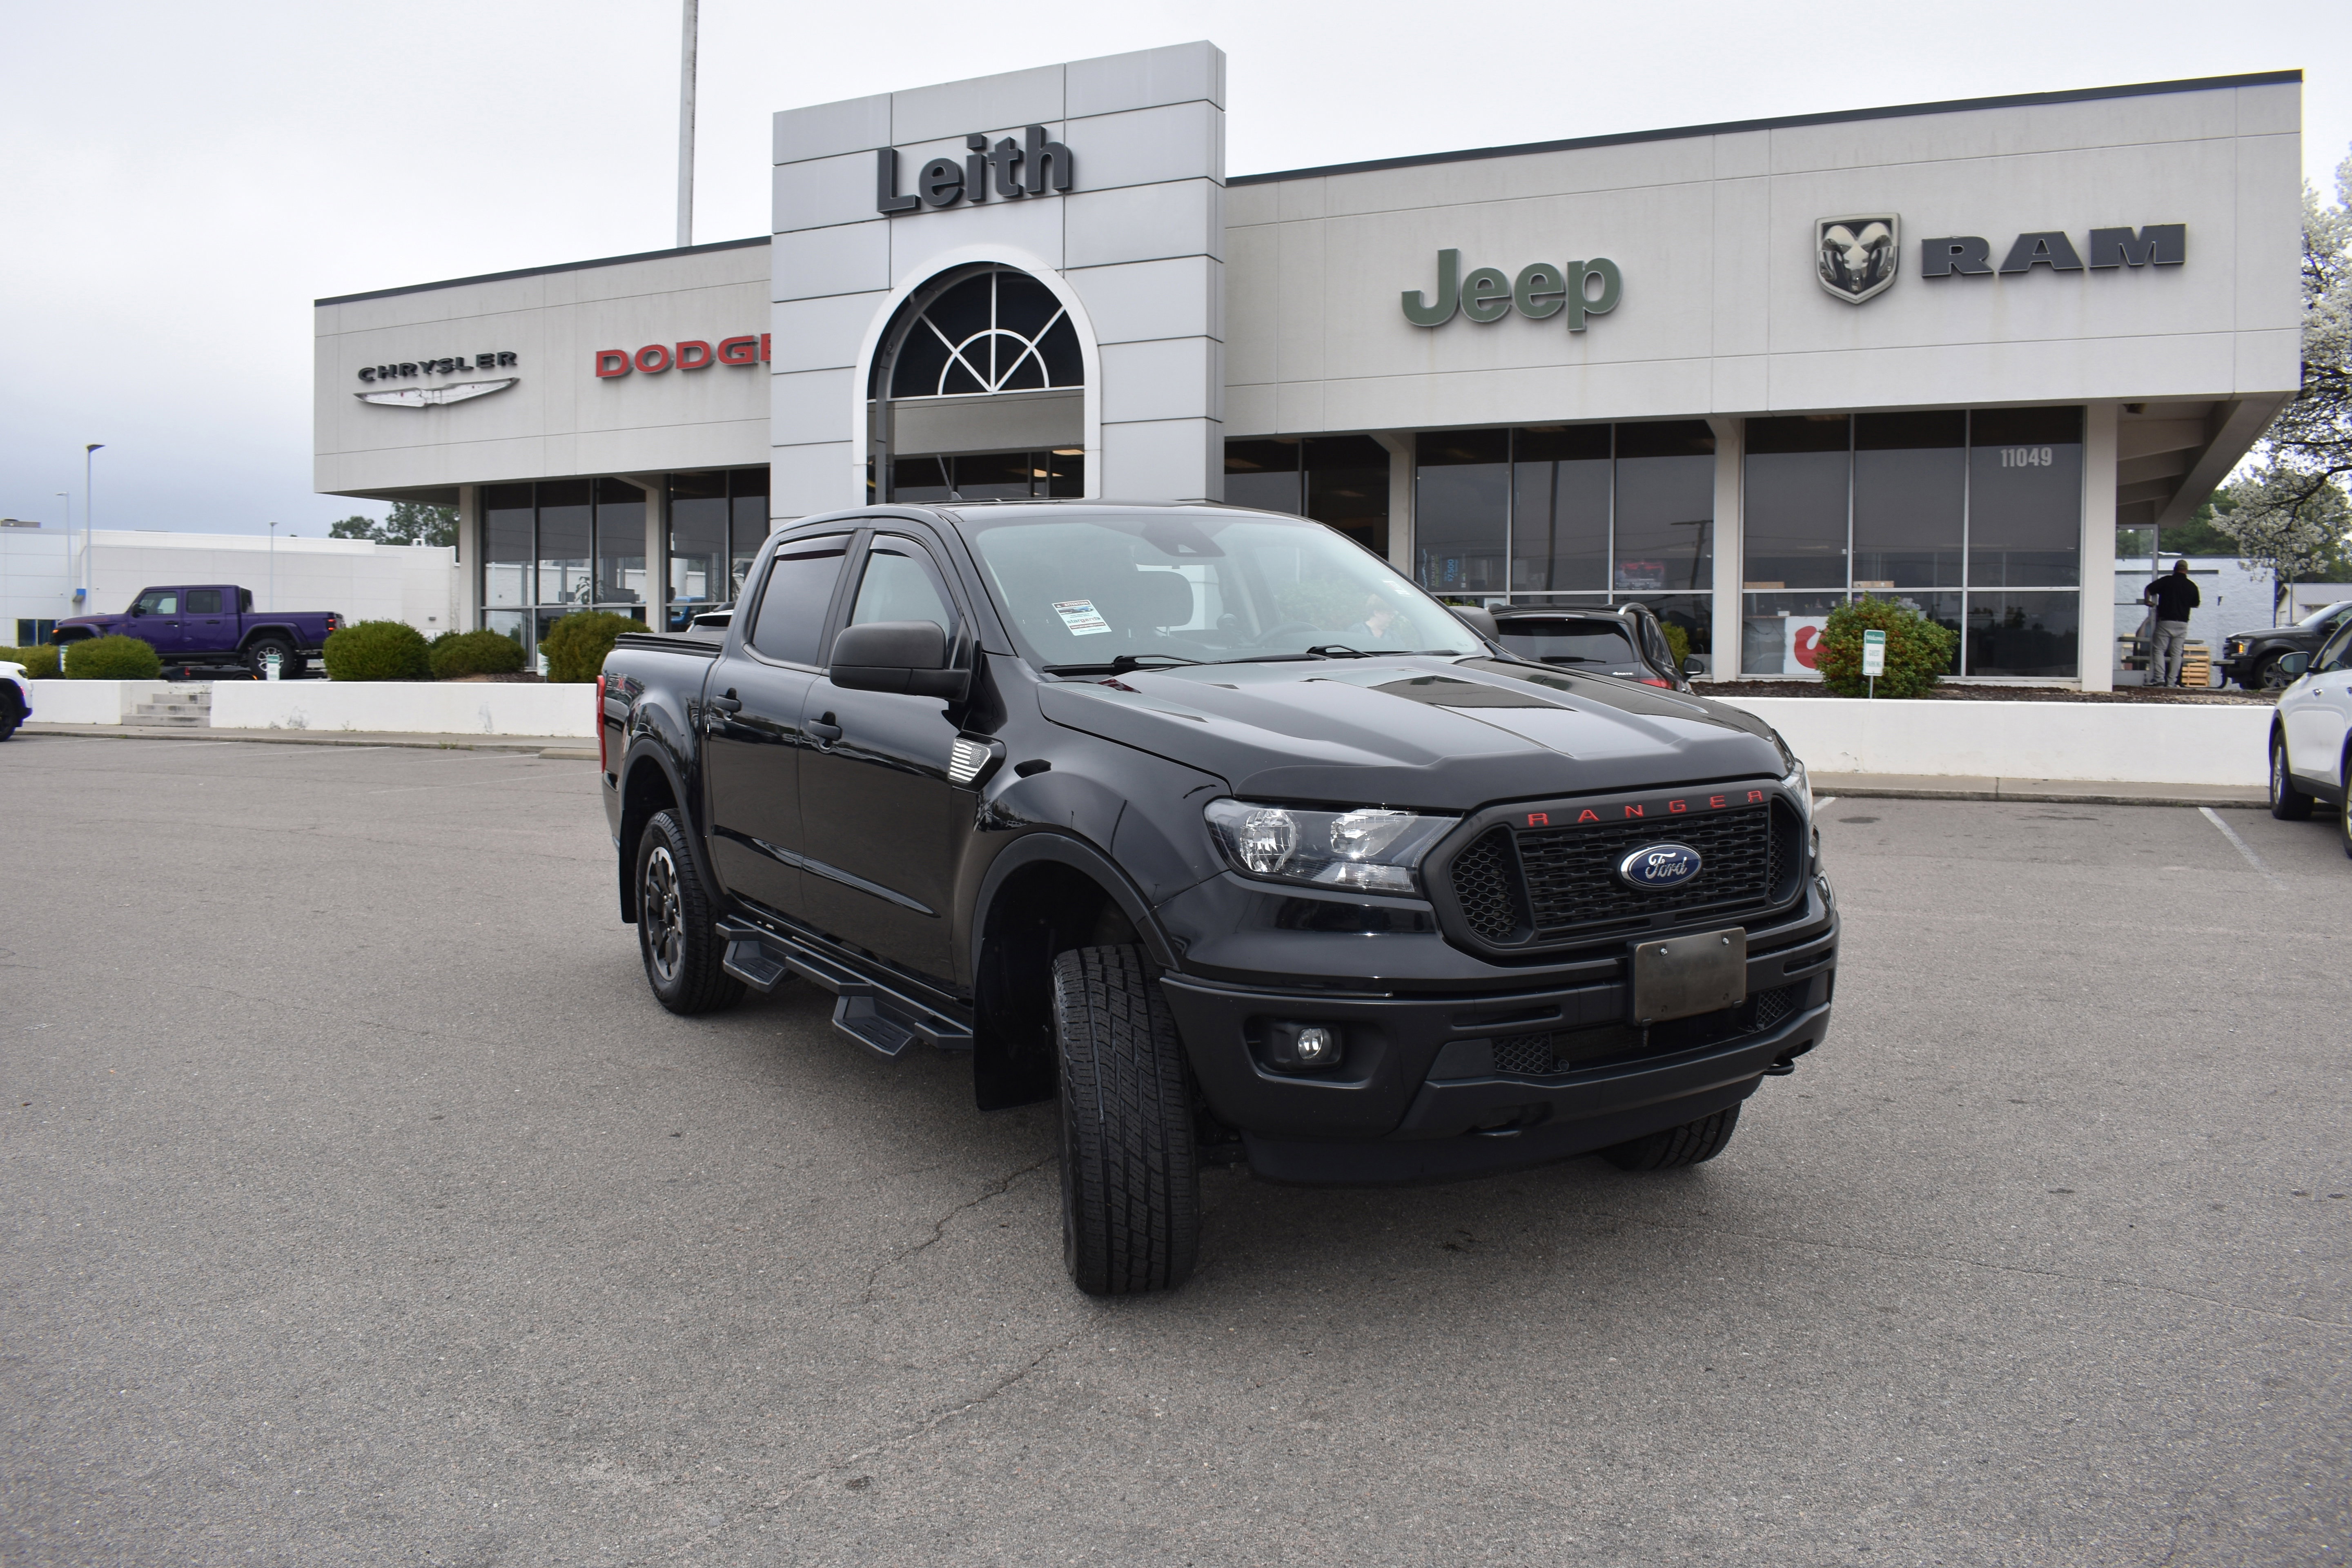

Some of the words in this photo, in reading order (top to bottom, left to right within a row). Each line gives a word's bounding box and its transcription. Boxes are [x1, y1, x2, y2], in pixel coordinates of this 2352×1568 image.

[877, 125, 1073, 214] Leith
[1922, 223, 2186, 278] RAM
[1401, 248, 1623, 333] Jeep
[358, 351, 518, 382] CHRYSLER
[2000, 447, 2052, 467] 11049
[1528, 790, 1763, 827] RANGER
[1645, 852, 1688, 880] Ford
